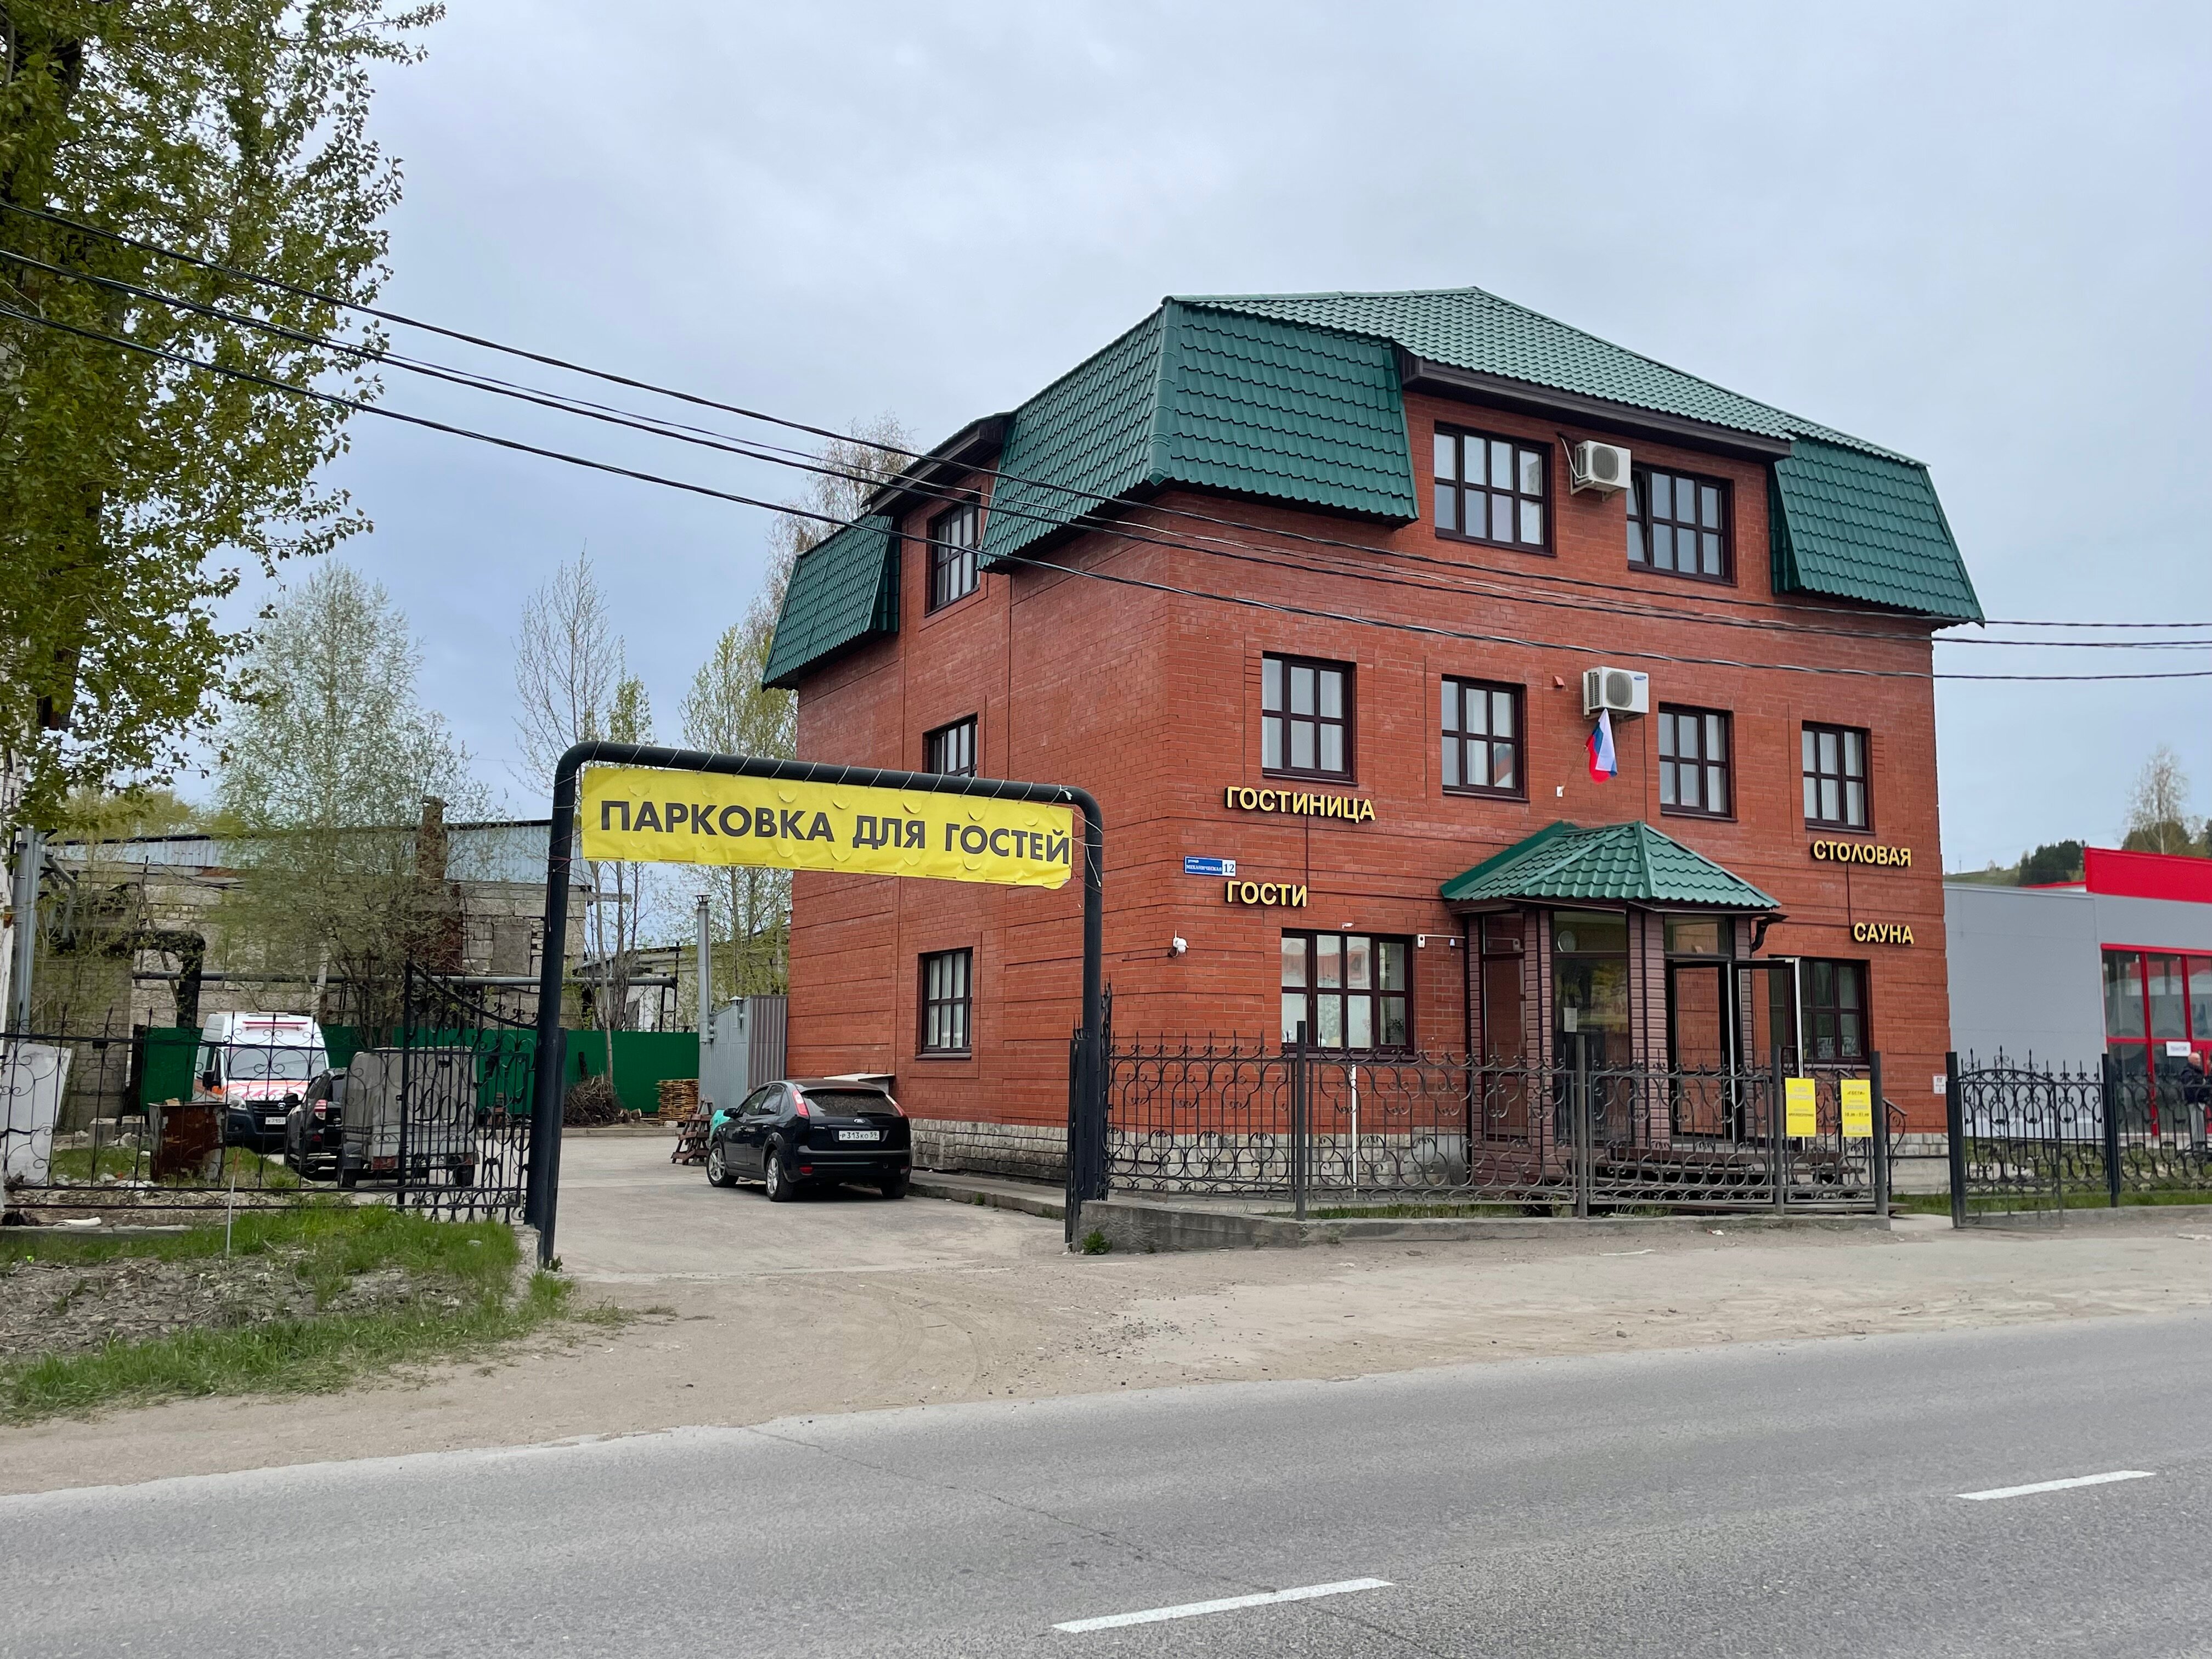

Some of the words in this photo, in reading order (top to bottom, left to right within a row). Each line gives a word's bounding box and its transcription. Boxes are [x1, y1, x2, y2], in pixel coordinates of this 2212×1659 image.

[1227, 786, 1376, 824] ГОСТИНИЦА
[601, 800, 836, 843] ПАРКОВКА
[853, 815, 926, 850] ДЛЯ
[945, 822, 1070, 865] ГОСТЕЙ
[1813, 839, 1911, 867] СТОЛОВАЯ
[1224, 864, 1234, 873] 12
[1227, 880, 1307, 907] ГОСТИ
[1853, 922, 1914, 945] САУНА
